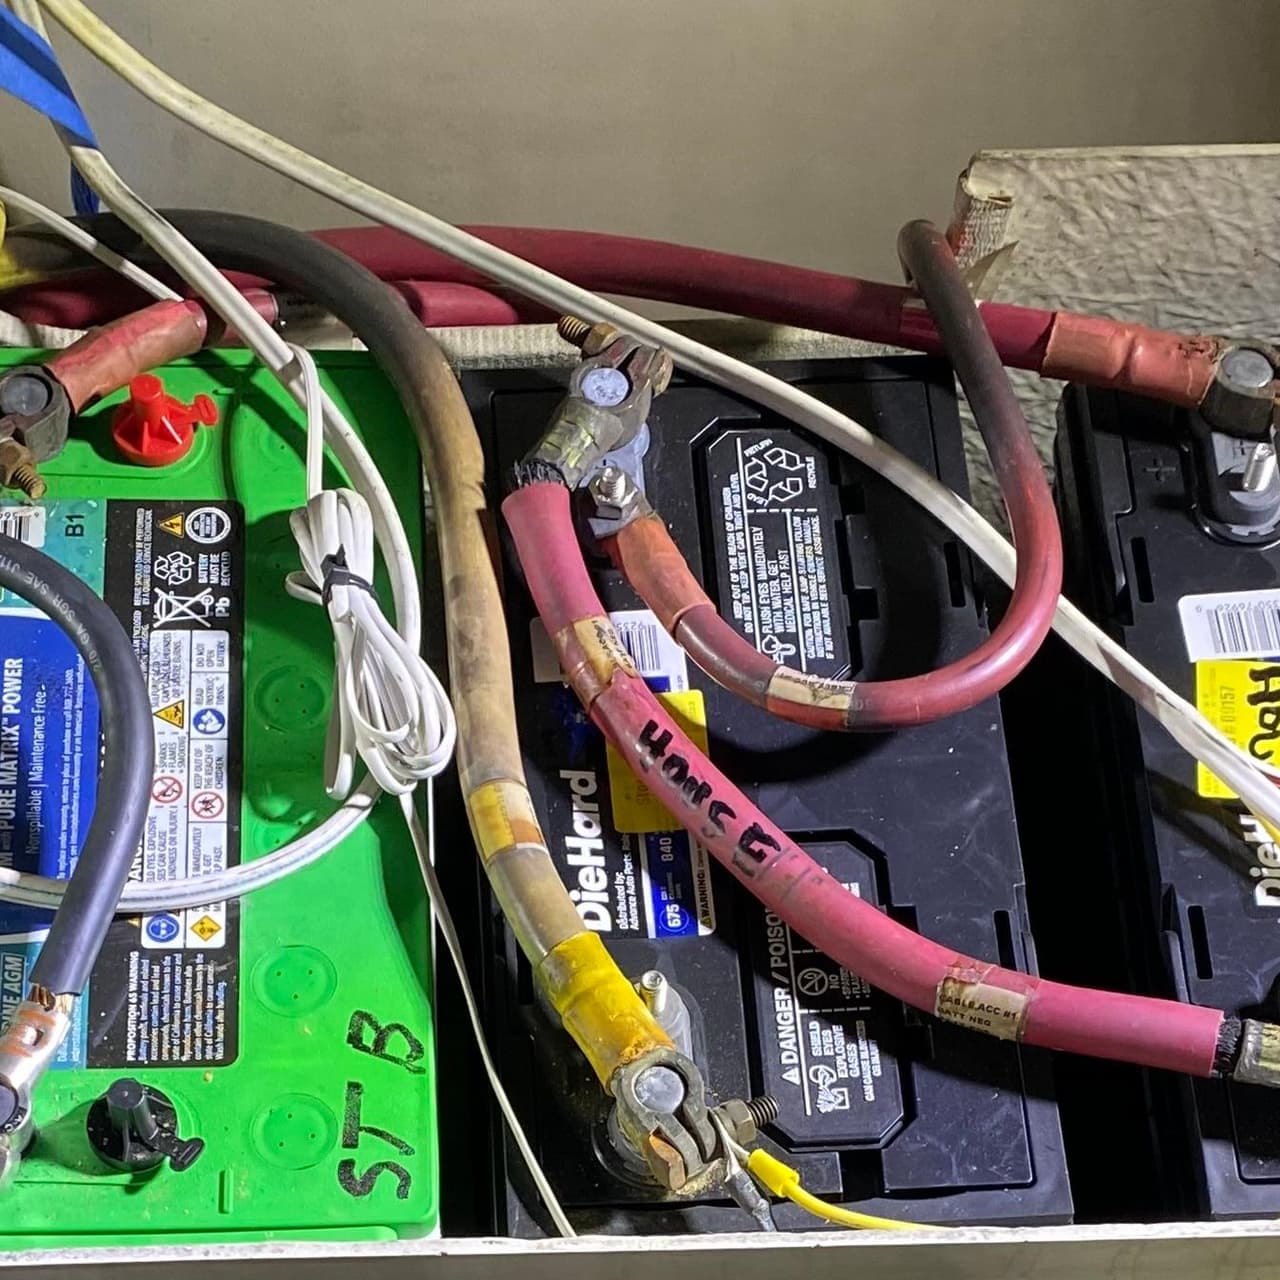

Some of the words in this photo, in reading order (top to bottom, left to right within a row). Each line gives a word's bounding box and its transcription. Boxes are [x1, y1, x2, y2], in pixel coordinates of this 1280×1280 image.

[805, 456, 817, 488] RECYCLE
[64, 514, 84, 536] B1
[198, 553, 208, 583] BATTERY
[210, 553, 219, 562] BE
[220, 551, 230, 585] RECYCLED
[751, 526, 768, 580] IMMEDIATELY
[768, 559, 778, 575] GET
[777, 549, 789, 569] FAST
[210, 563, 219, 583] MUST
[780, 572, 792, 593] HELP
[215, 597, 229, 616] Pb
[757, 582, 769, 603] EYES
[759, 606, 772, 633] FLUSH
[772, 610, 784, 632] WITH
[782, 596, 796, 632] MEDICAL
[1, 657, 24, 713] POWER
[31, 691, 46, 713] Free
[27, 715, 47, 781] Maintenance
[24, 789, 46, 853] Nonspillable
[556, 769, 614, 931] DieHard
[658, 837, 673, 861] 840
[624, 876, 635, 894] Auto
[697, 869, 710, 917] WARNING:
[615, 886, 629, 928] Distributed
[626, 896, 640, 930] Advance
[665, 903, 681, 928] 675
[2, 955, 23, 992] AGM
[128, 950, 139, 990] WARNING
[125, 1004, 137, 1060] PROPOSITION
[774, 987, 797, 1063] DANGER
[808, 1020, 822, 1055] SHIELD
[821, 1030, 834, 1055] EYES
[832, 1024, 848, 1077] EXPLOSIVE
[847, 1043, 860, 1077] GASES
